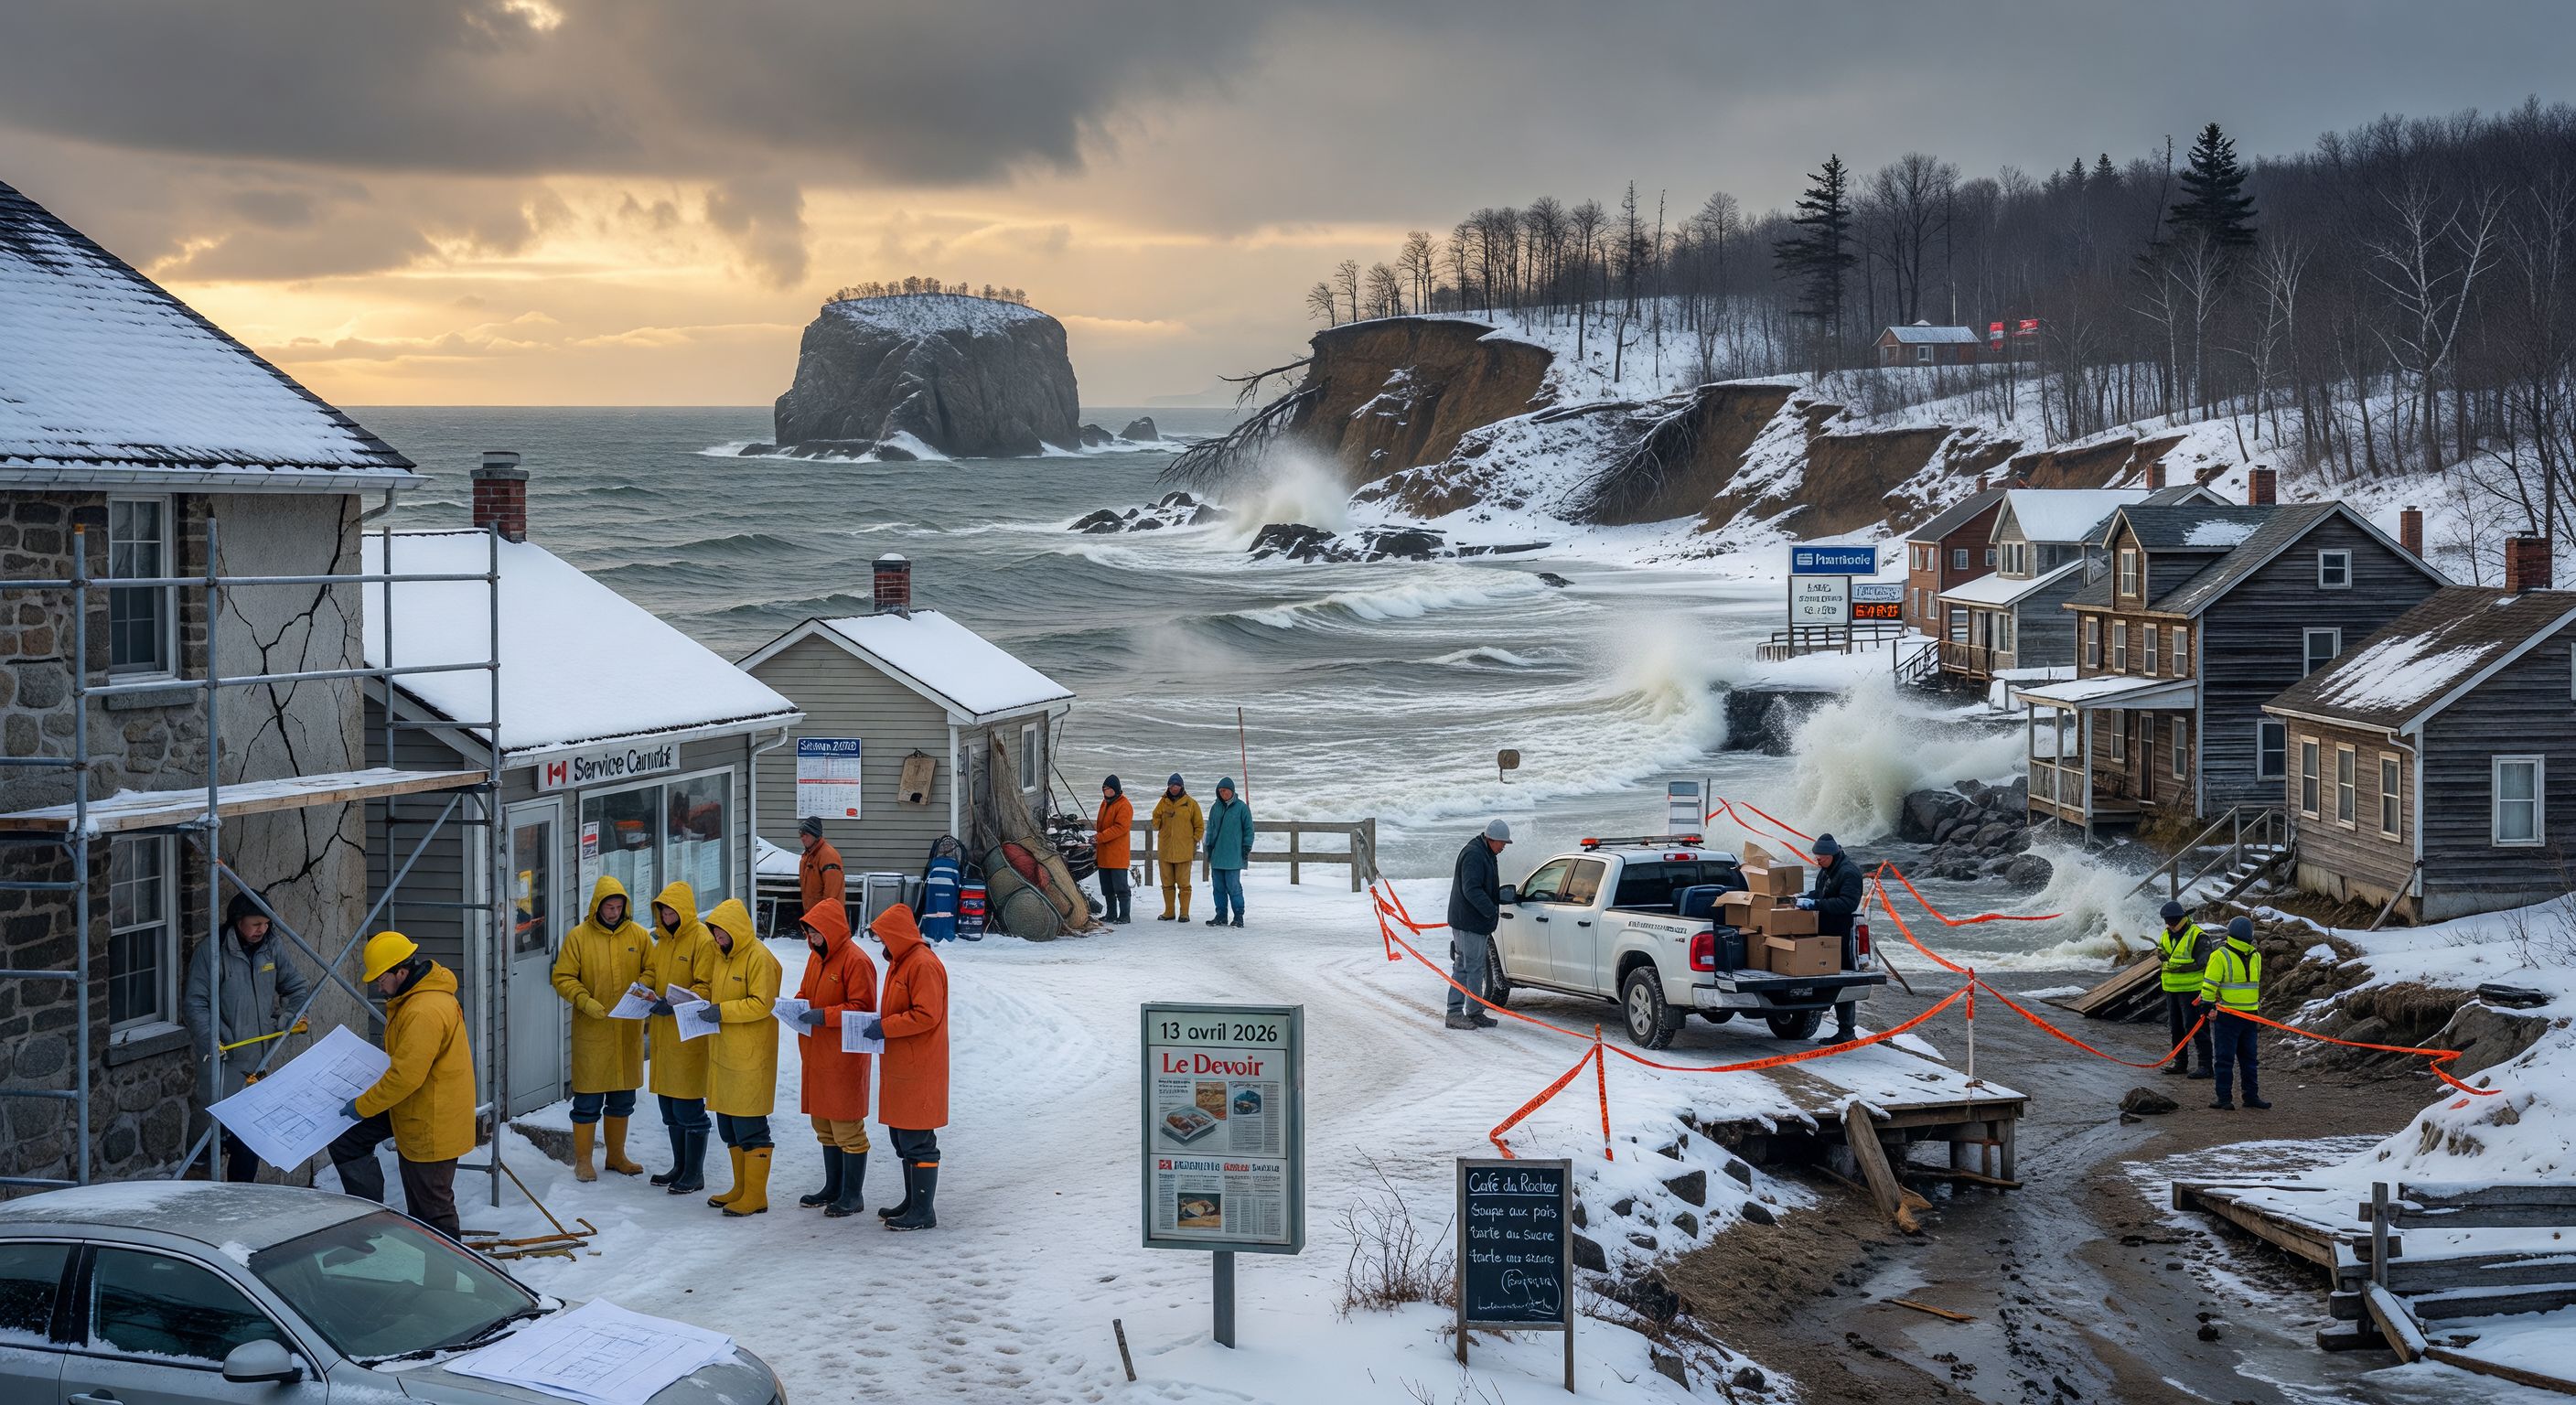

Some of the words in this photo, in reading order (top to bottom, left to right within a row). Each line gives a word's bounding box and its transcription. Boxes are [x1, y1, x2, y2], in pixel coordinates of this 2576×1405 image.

[574, 753, 624, 781] Service
[1160, 1022, 1180, 1039] 13
[1187, 1023, 1226, 1041] avril
[1233, 1024, 1278, 1042] 2026
[1163, 1053, 1188, 1074] Le
[1194, 1053, 1264, 1077] Devoir
[1469, 1173, 1499, 1193] Café
[1508, 1207, 1529, 1217] aux
[1533, 1204, 1557, 1223] pois
[1470, 1225, 1500, 1239] tarte
[1506, 1230, 1520, 1239] au
[1469, 1248, 1502, 1263] tarte
